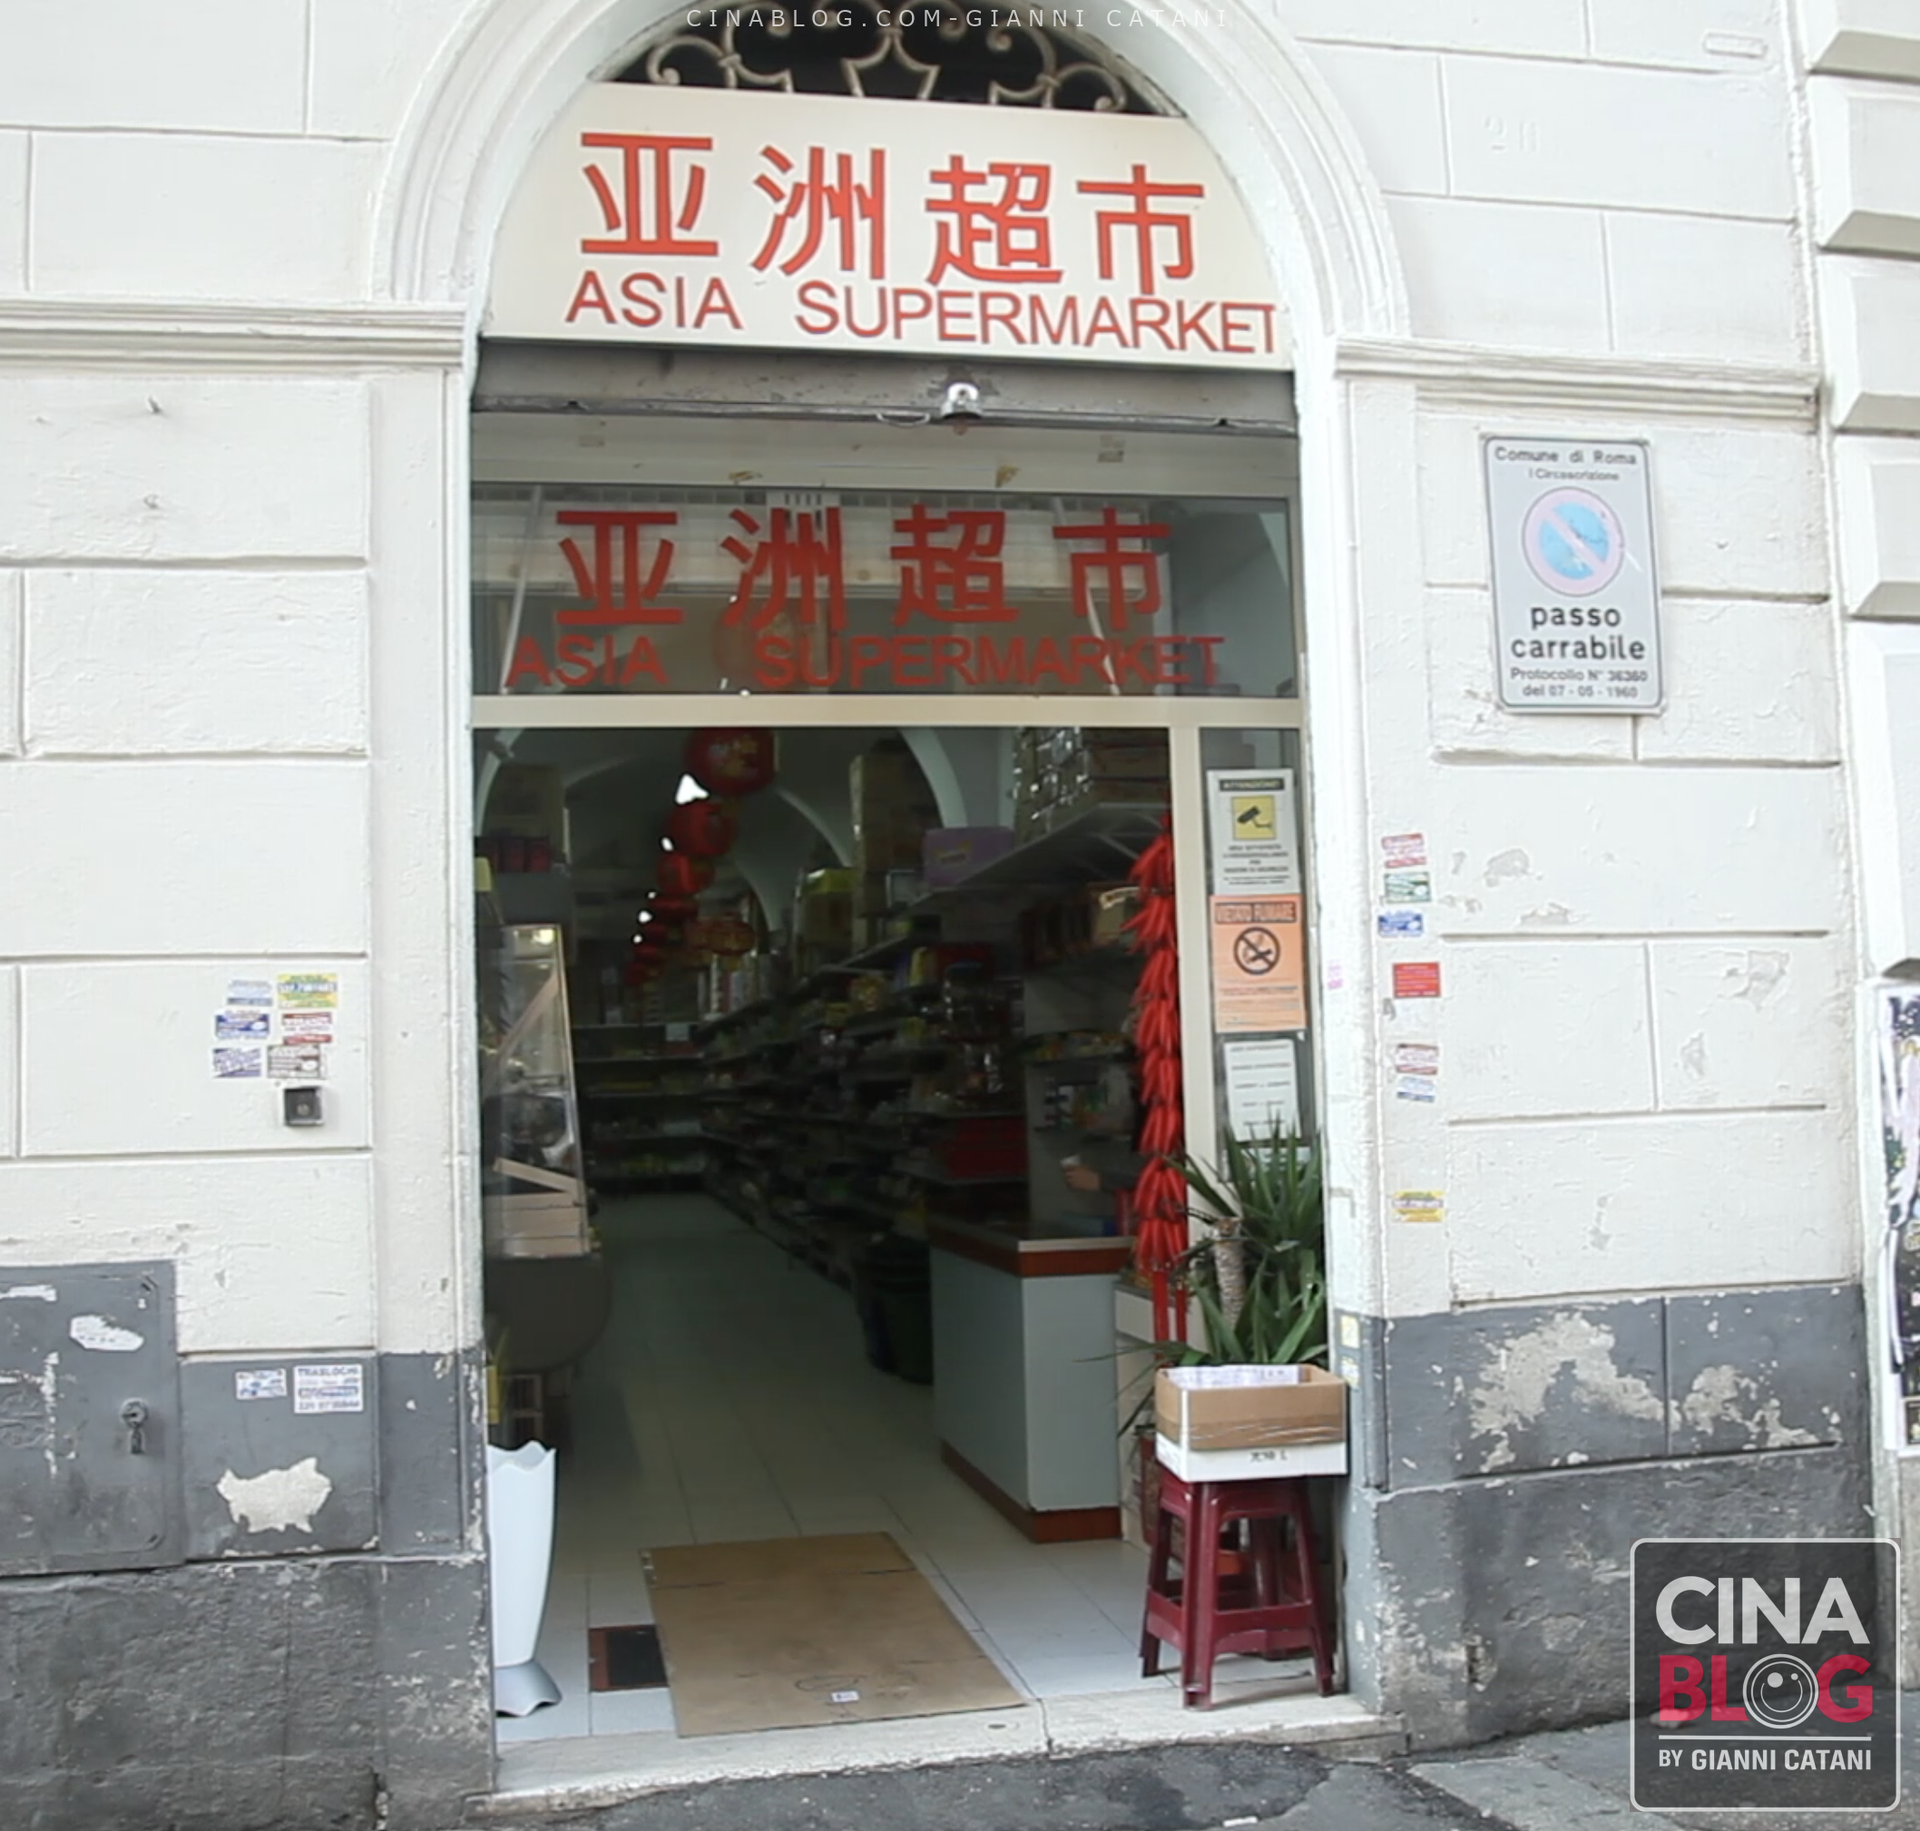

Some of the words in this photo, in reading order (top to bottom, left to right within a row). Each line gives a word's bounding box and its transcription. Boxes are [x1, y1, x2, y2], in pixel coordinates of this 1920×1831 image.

[580, 133, 1206, 295] 亚洲超市
[565, 270, 743, 331] ASIA
[795, 281, 1277, 354] SUPERMARKET
[1494, 446, 1559, 462] Comune
[1569, 449, 1584, 463] di
[1593, 450, 1637, 465] Roma
[555, 504, 1172, 631] 亚洲超市
[1530, 606, 1622, 630] passo
[1511, 635, 1646, 661] carrabile
[504, 635, 669, 688] ASIA
[754, 635, 1225, 688] SUPERMARKET
[1510, 668, 1585, 682] Protocollo
[1522, 684, 1545, 696] del
[1548, 685, 1566, 697] 07
